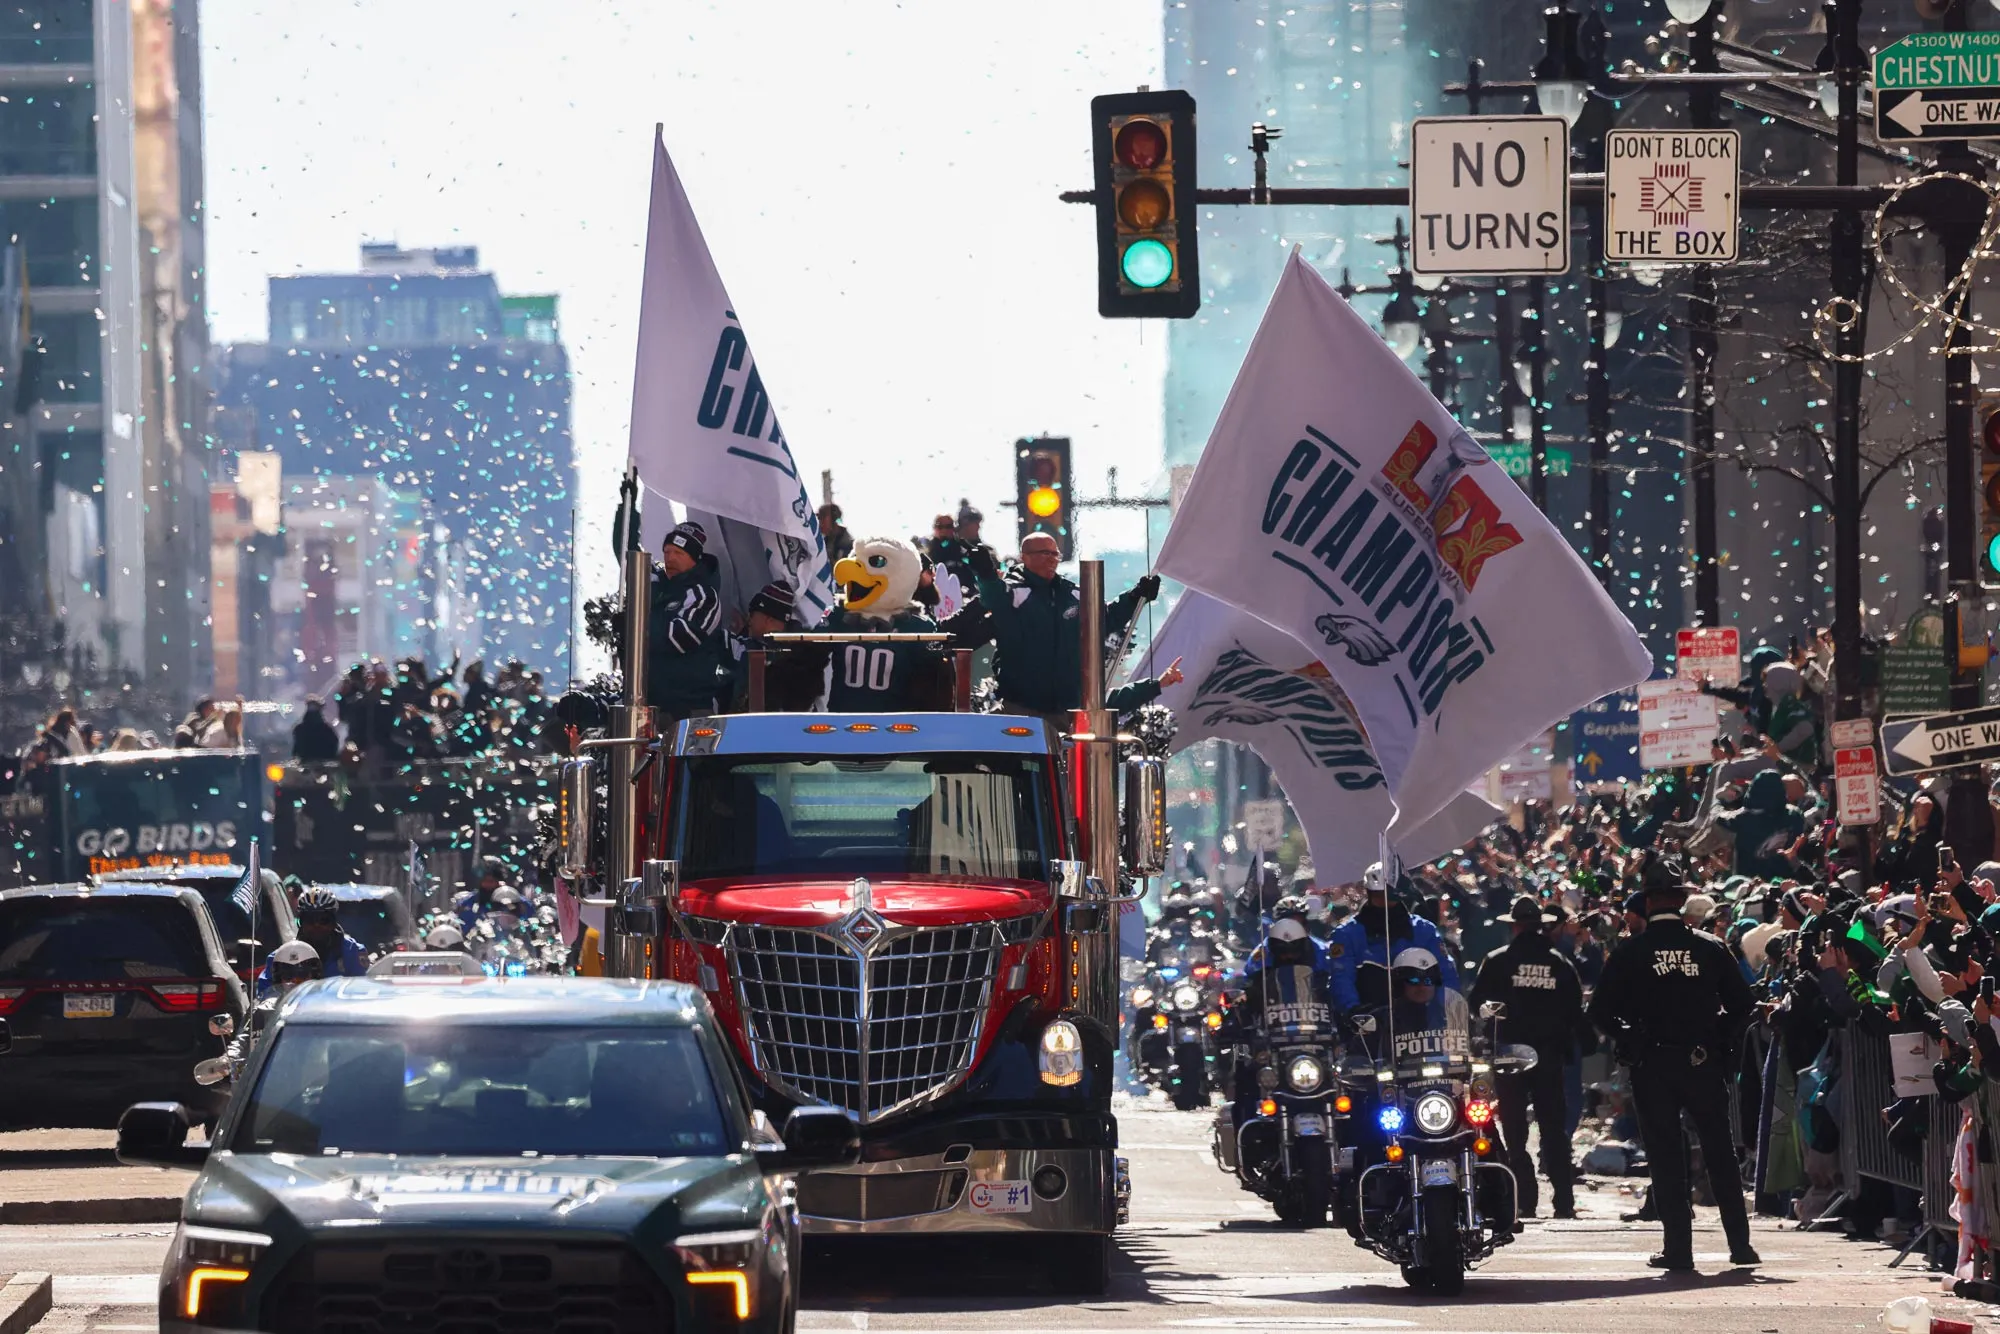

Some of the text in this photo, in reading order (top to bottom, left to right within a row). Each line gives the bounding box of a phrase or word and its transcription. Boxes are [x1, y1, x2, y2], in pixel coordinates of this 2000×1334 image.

[1915, 33, 2000, 49] 1300 W 1400
[1926, 103, 1969, 123] ONE
[1613, 136, 1731, 159] DON'T BLOCK
[1452, 139, 1526, 188] NO
[1420, 211, 1560, 251] TURNS
[1615, 231, 1727, 255] THE BOX
[1382, 481, 1435, 542] SUPER
[844, 645, 895, 691] 00
[1931, 722, 2000, 751] ONE W
[1847, 778, 1867, 792] BUS
[1846, 791, 1869, 806] ZONE
[77, 820, 238, 857] GO BIRDS
[1518, 963, 1551, 978] STATE
[1511, 975, 1557, 990] TROOPER
[1267, 1008, 1331, 1025] POLICE
[1395, 1029, 1468, 1043] PHILADELPHIA
[1395, 1037, 1469, 1057] POLICE
[1008, 1184, 1029, 1206] #1
